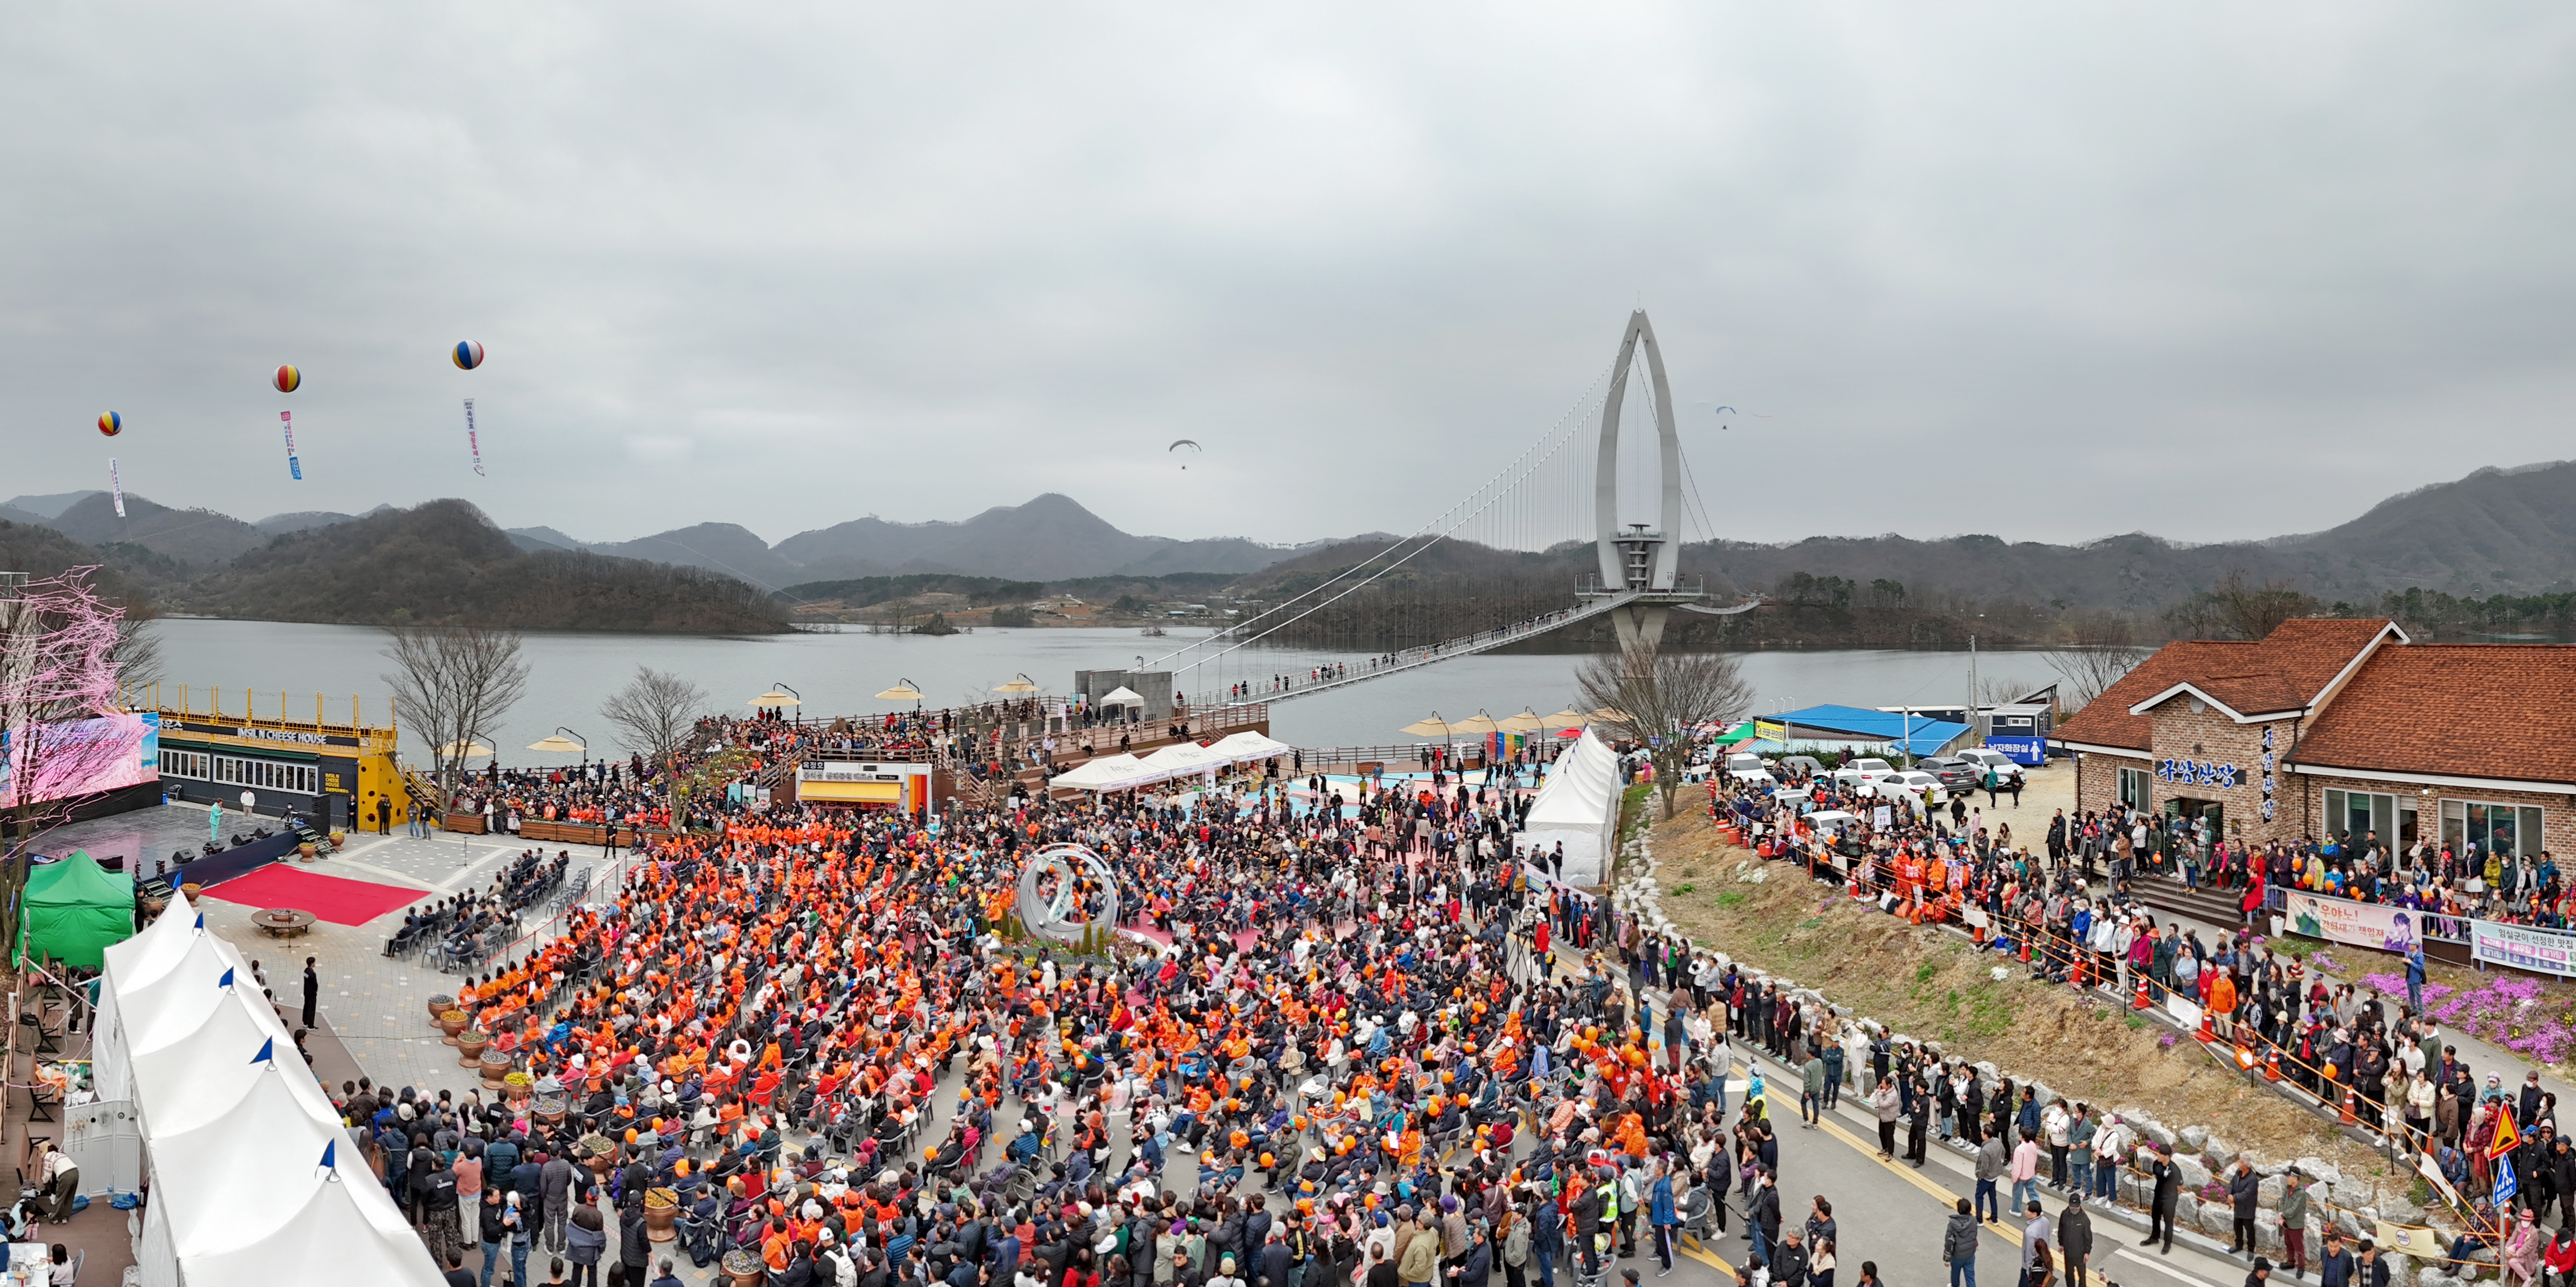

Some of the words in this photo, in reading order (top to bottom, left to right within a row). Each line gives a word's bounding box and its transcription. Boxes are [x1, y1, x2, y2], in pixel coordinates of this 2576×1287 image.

[466, 410, 475, 429] 옥정호
[469, 430, 479, 456] 벚꽃축제
[237, 728, 258, 739] IMSIL
[259, 729, 266, 739] N
[266, 732, 297, 742] CHEESE
[298, 733, 327, 744] HOUSE
[1988, 743, 2029, 753] 남자화장실
[2159, 759, 2237, 789] 구암산장
[2262, 729, 2275, 819] 구암산장
[2320, 905, 2359, 922] 우야노!
[2322, 919, 2356, 934] 김희재가
[2358, 926, 2385, 939] 책임져
[2498, 929, 2529, 942] 임실군이
[2532, 935, 2555, 947] 선정한
[2558, 939, 2574, 950] 맛집
[2483, 949, 2503, 959] 메기탕
[2512, 944, 2532, 954] 새우탕
[2542, 949, 2563, 959] 빠가탕
[2496, 1185, 2513, 1202] 횡단보도
